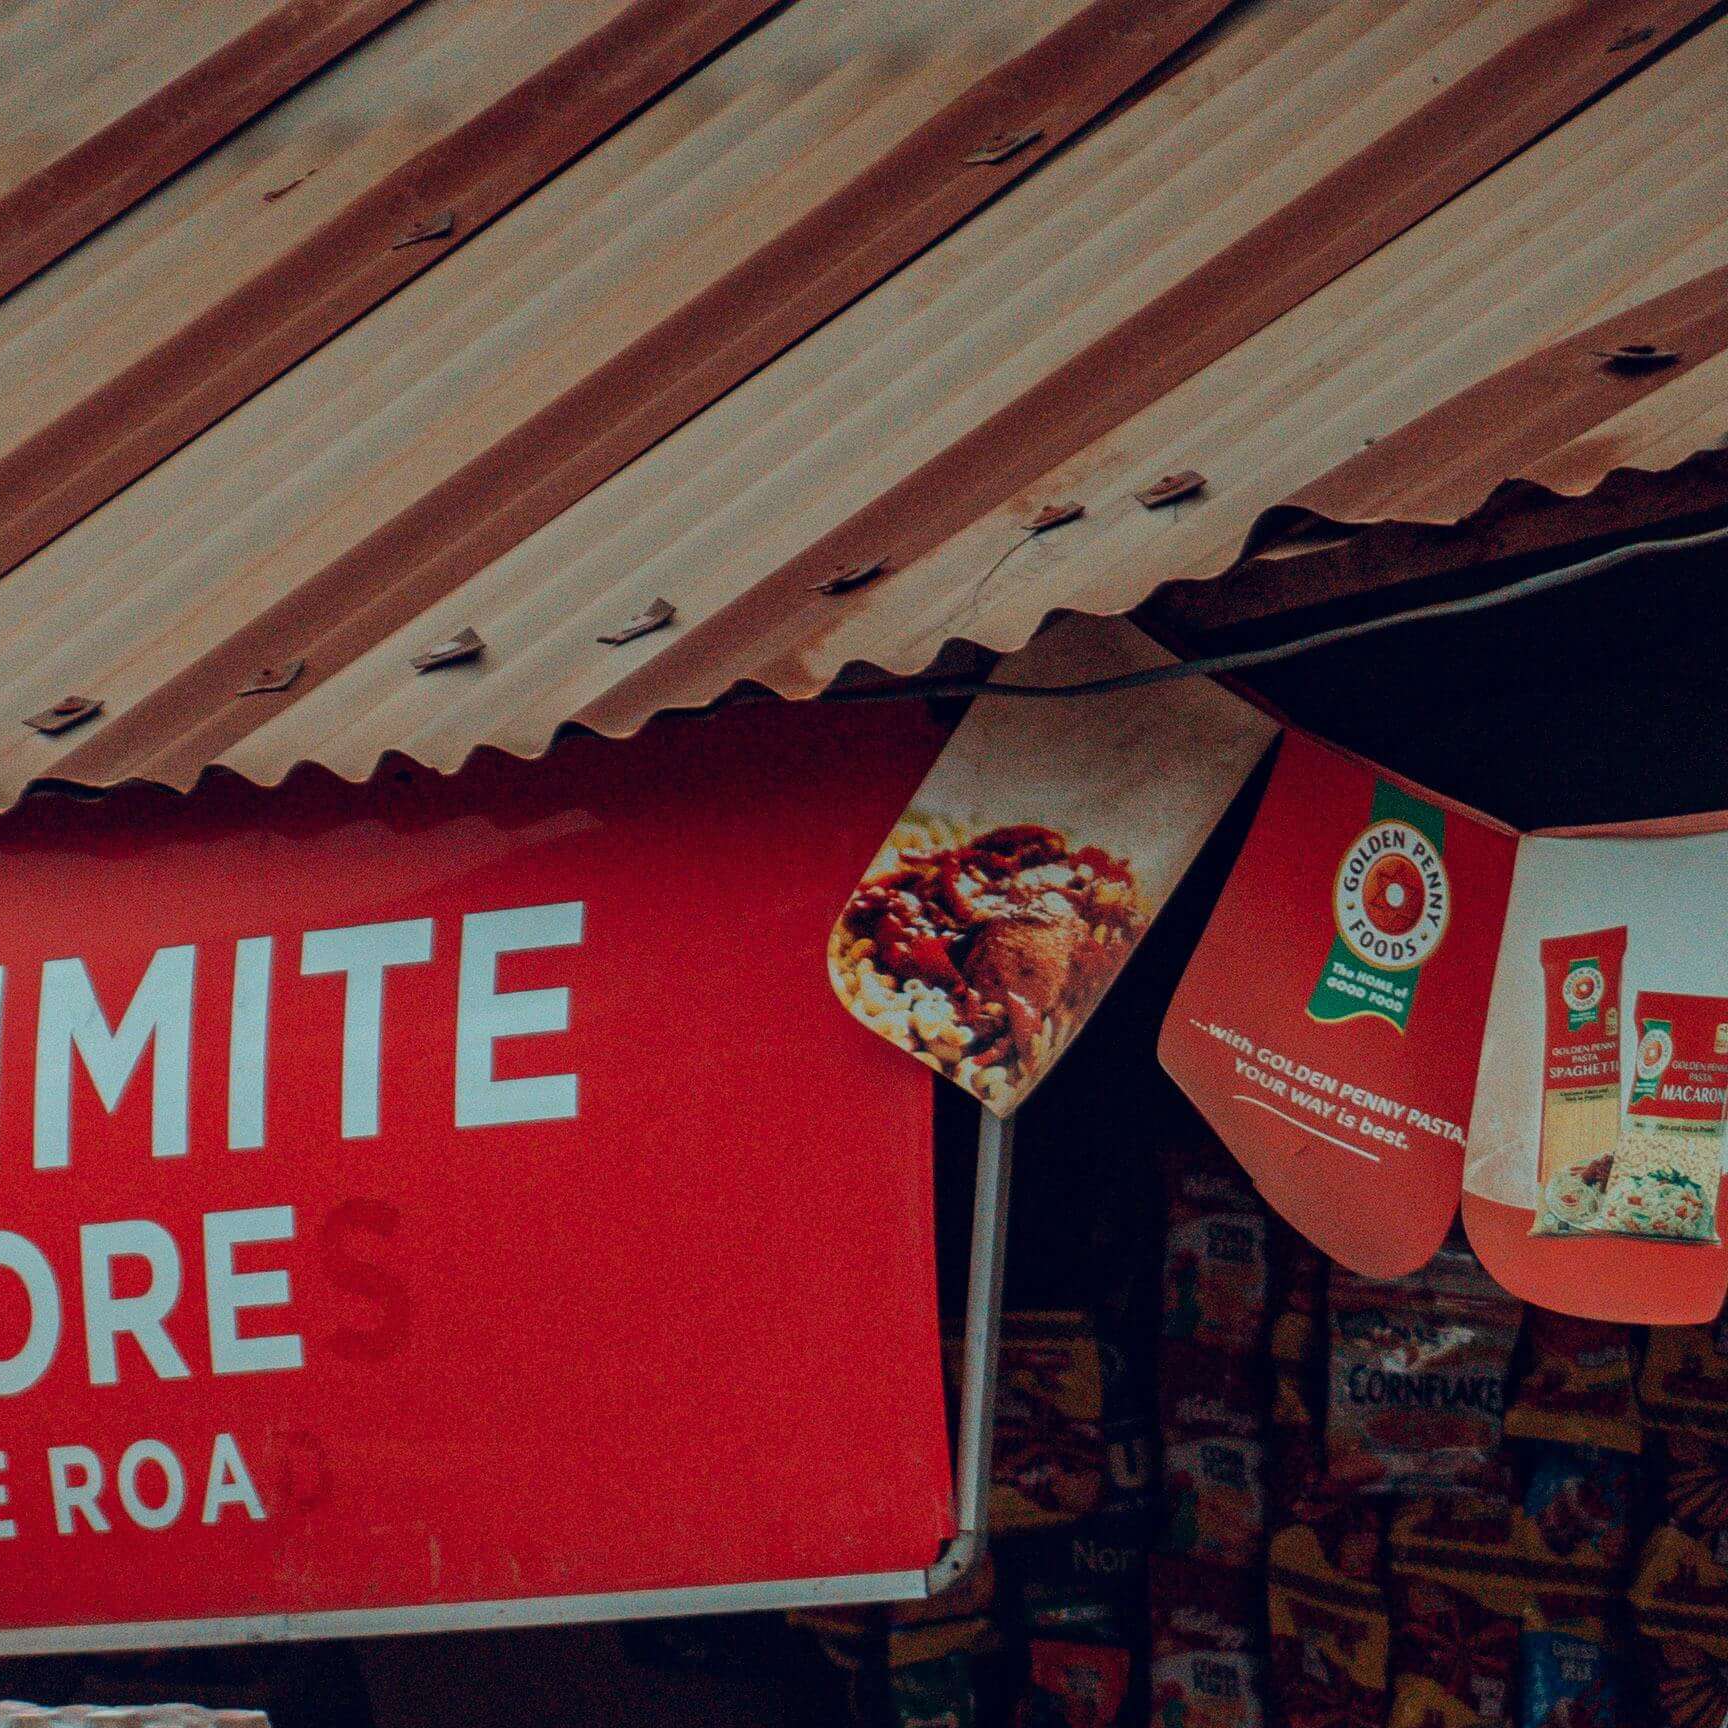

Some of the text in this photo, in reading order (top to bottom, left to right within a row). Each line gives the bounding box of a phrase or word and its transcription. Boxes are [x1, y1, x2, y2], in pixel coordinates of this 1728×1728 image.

[1343, 829, 1445, 928] GOLDEN PENNY
[1347, 918, 1418, 960] FOODS
[1326, 976, 1404, 1013] GOOD FOOD
[1332, 962, 1409, 999] The HOME of
[1234, 1057, 1409, 1149] YOUR WAY is best.
[1258, 1048, 1338, 1094] GOLDEN
[1339, 1083, 1406, 1120] PENNY
[1407, 1109, 1468, 1147] PASTA,
